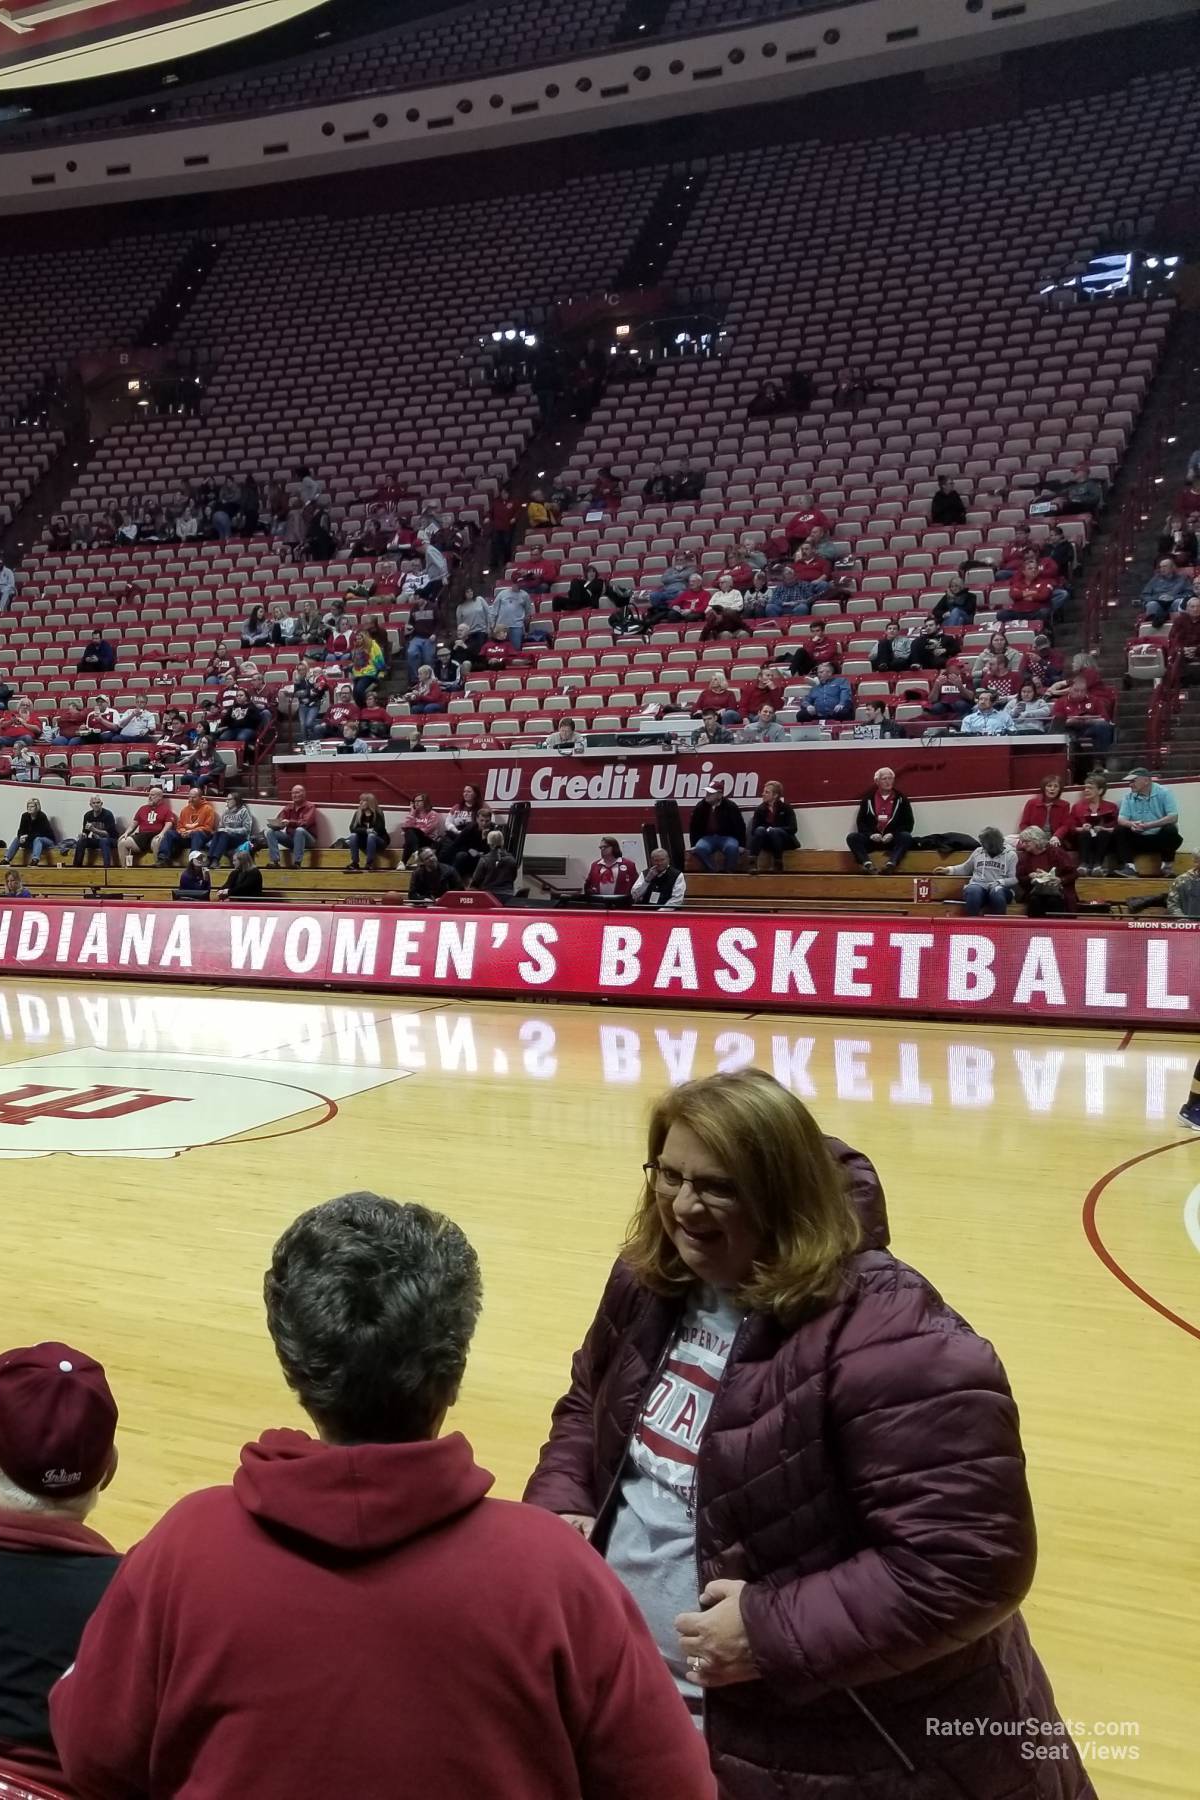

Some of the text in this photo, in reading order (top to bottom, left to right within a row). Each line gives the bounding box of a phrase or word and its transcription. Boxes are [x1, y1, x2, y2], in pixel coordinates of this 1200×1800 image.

[484, 761, 759, 800] IU Credit Union
[230, 914, 559, 984] WOMEN'S
[599, 925, 1190, 1010] BASKETBALL
[680, 1327, 730, 1356] OPERTY
[42, 1468, 82, 1486] Indiana
